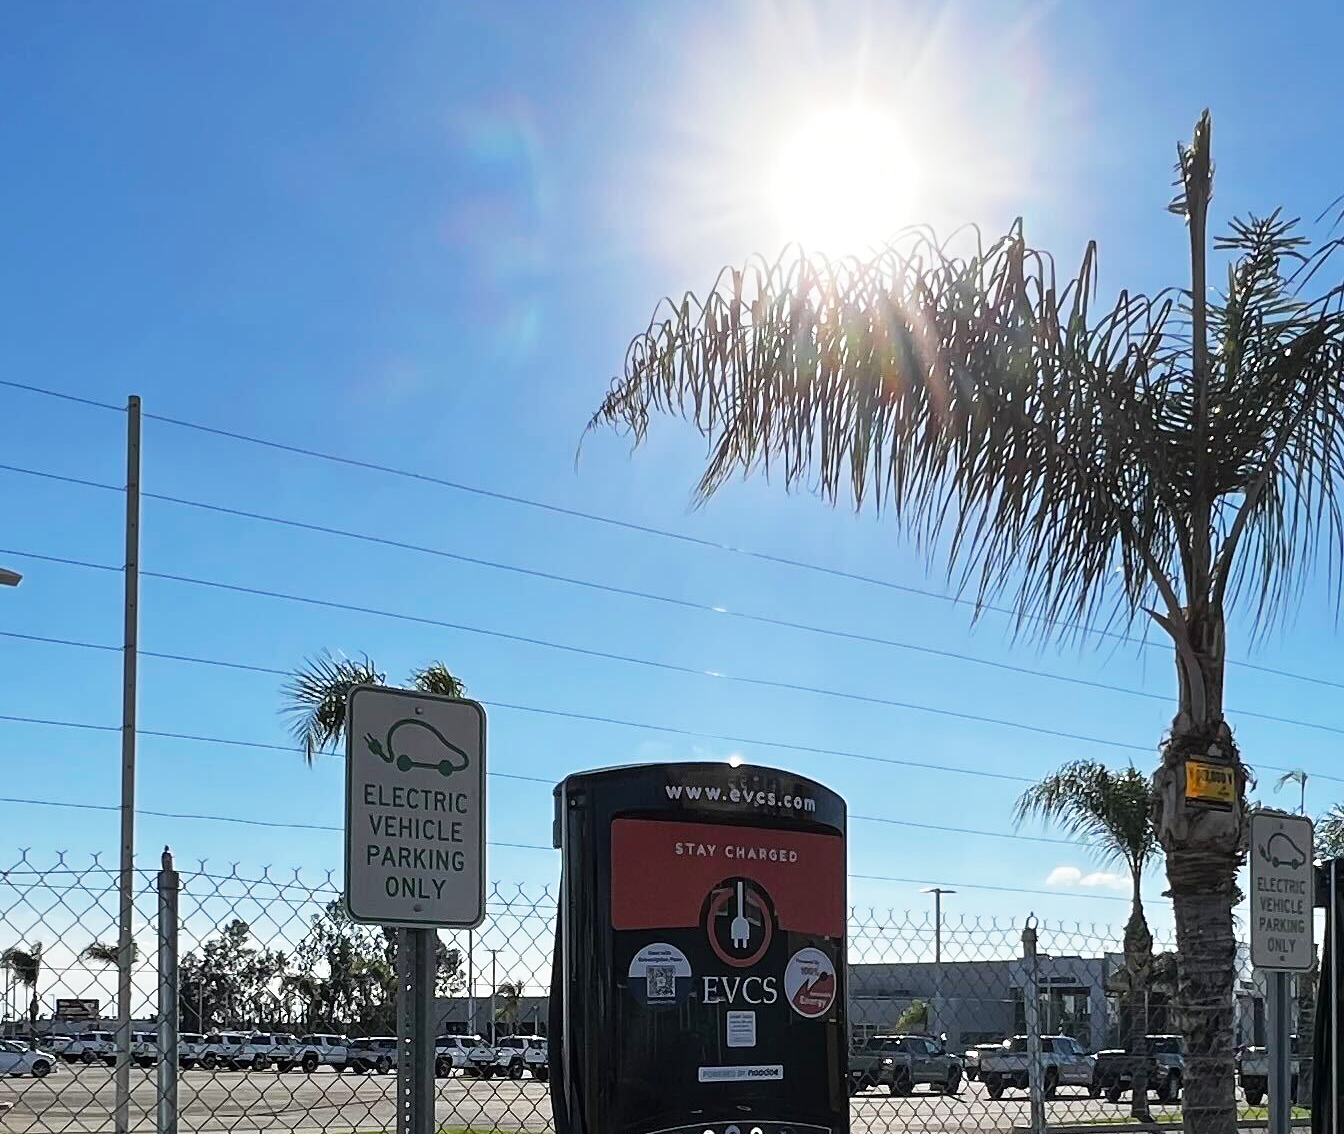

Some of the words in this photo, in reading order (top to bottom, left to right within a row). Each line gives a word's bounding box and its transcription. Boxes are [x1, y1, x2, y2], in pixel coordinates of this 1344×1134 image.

[363, 783, 468, 815] ELECTRIC
[664, 785, 817, 813] www.evcs.com
[368, 813, 463, 843] VEHICLE
[366, 844, 465, 872] PARKING
[674, 842, 717, 857] STAY
[724, 845, 799, 863] CHARGED
[384, 875, 447, 900] ONLY
[1257, 876, 1306, 895] ELECTRIC
[1259, 896, 1304, 915] VEHICLE
[1259, 916, 1305, 934] PARKING
[1267, 937, 1296, 954] ONLY
[702, 975, 778, 1005] EVCS
